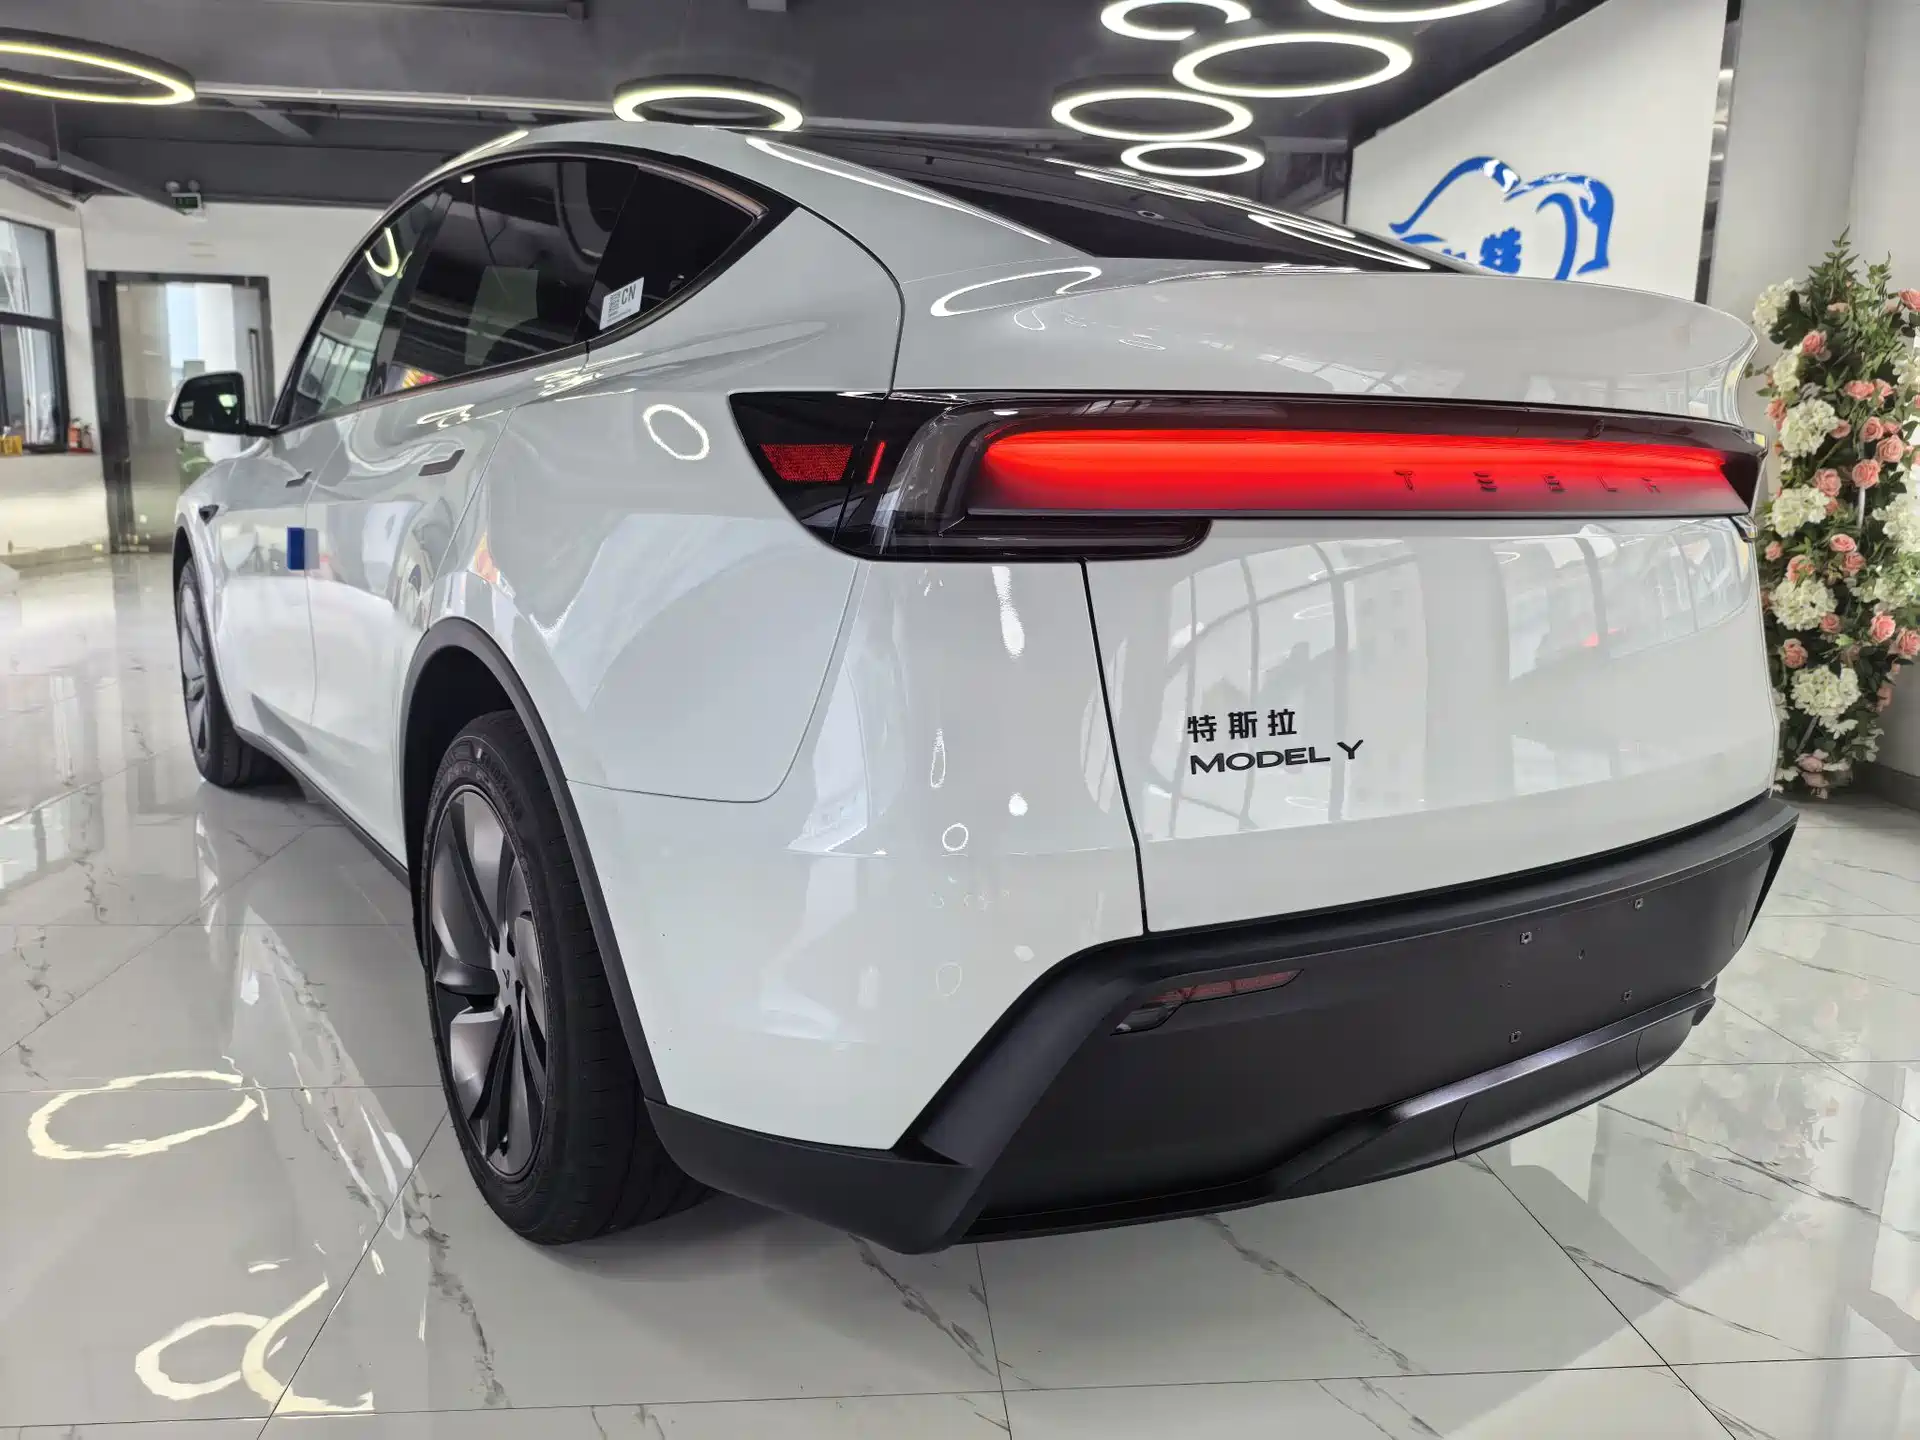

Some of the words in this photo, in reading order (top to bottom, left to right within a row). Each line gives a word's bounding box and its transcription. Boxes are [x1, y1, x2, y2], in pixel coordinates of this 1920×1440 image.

[622, 283, 637, 305] CN
[1394, 470, 1661, 493] TESLA
[1187, 708, 1298, 743] 特斯拉
[1190, 746, 1331, 775] MODEL
[1336, 739, 1364, 760] Y
